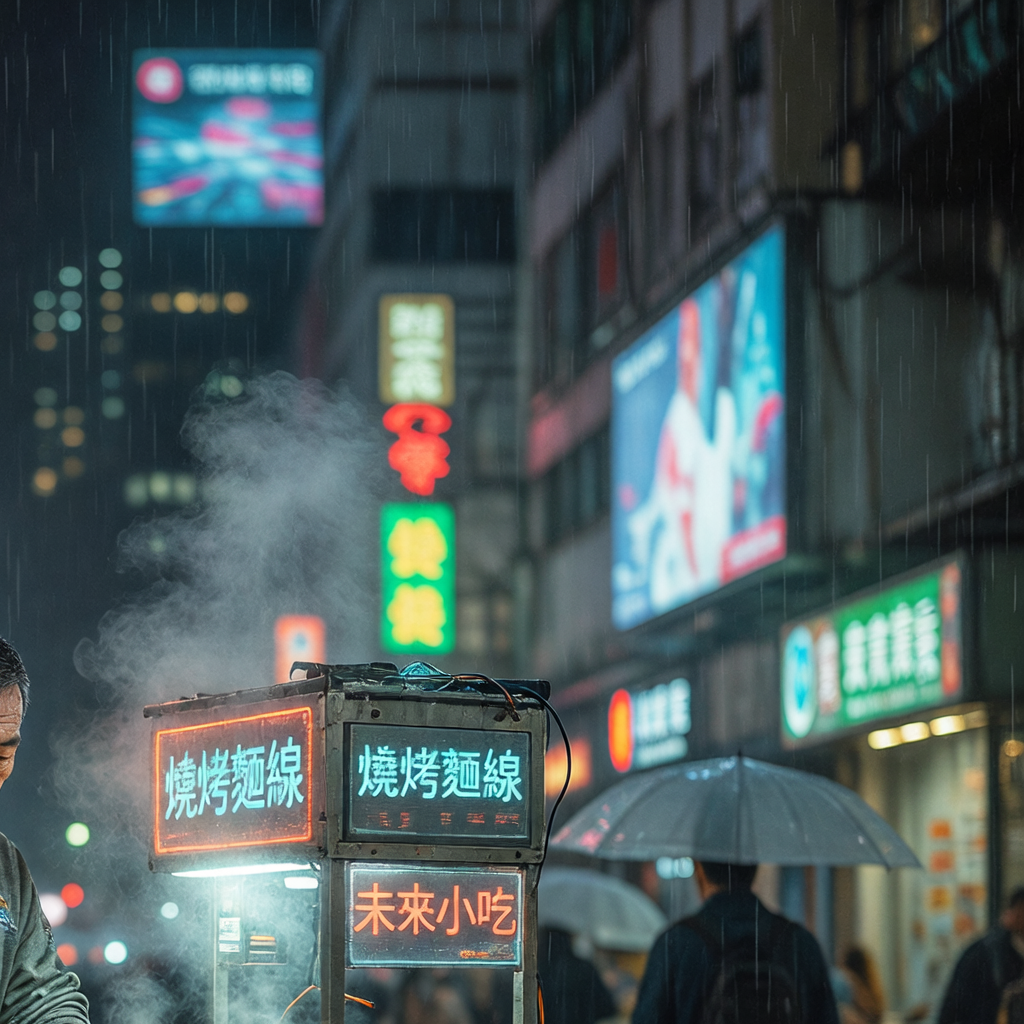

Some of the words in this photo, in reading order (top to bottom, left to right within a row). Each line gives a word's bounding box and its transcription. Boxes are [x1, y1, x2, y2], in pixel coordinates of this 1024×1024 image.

[164, 736, 305, 821] 燒烤麵線
[357, 744, 523, 803] 燒烤麵線
[353, 882, 517, 936] 未來小吃
